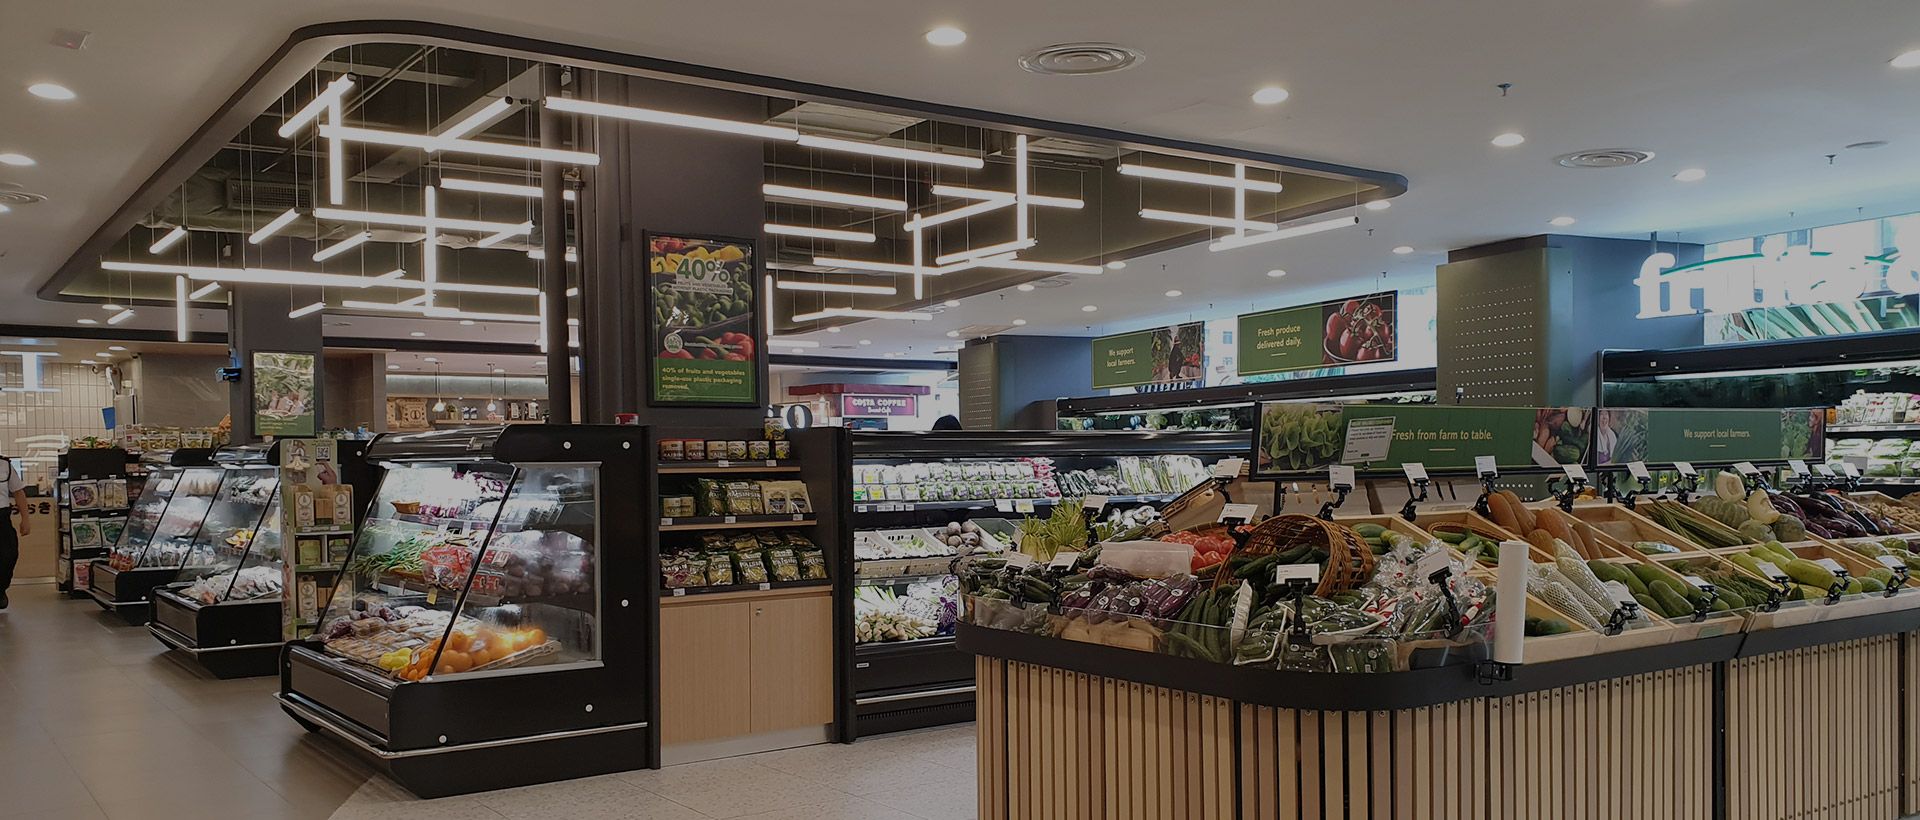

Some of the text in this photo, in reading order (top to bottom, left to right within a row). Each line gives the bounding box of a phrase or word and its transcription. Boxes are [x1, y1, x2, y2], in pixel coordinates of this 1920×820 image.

[676, 259, 729, 282] 40%
[1257, 325, 1301, 337] Fresh produce
[1256, 337, 1302, 350] delivered daily.
[1108, 347, 1134, 357] We support
[1118, 358, 1136, 367] farmers.
[852, 398, 906, 407] COSTA COFFEE
[1392, 429, 1414, 440] Fresh
[1417, 429, 1437, 440] from
[1439, 429, 1458, 440] farm
[1460, 430, 1469, 440] to
[1471, 429, 1493, 440] table.
[1683, 428, 1751, 440] We support local farmers.
